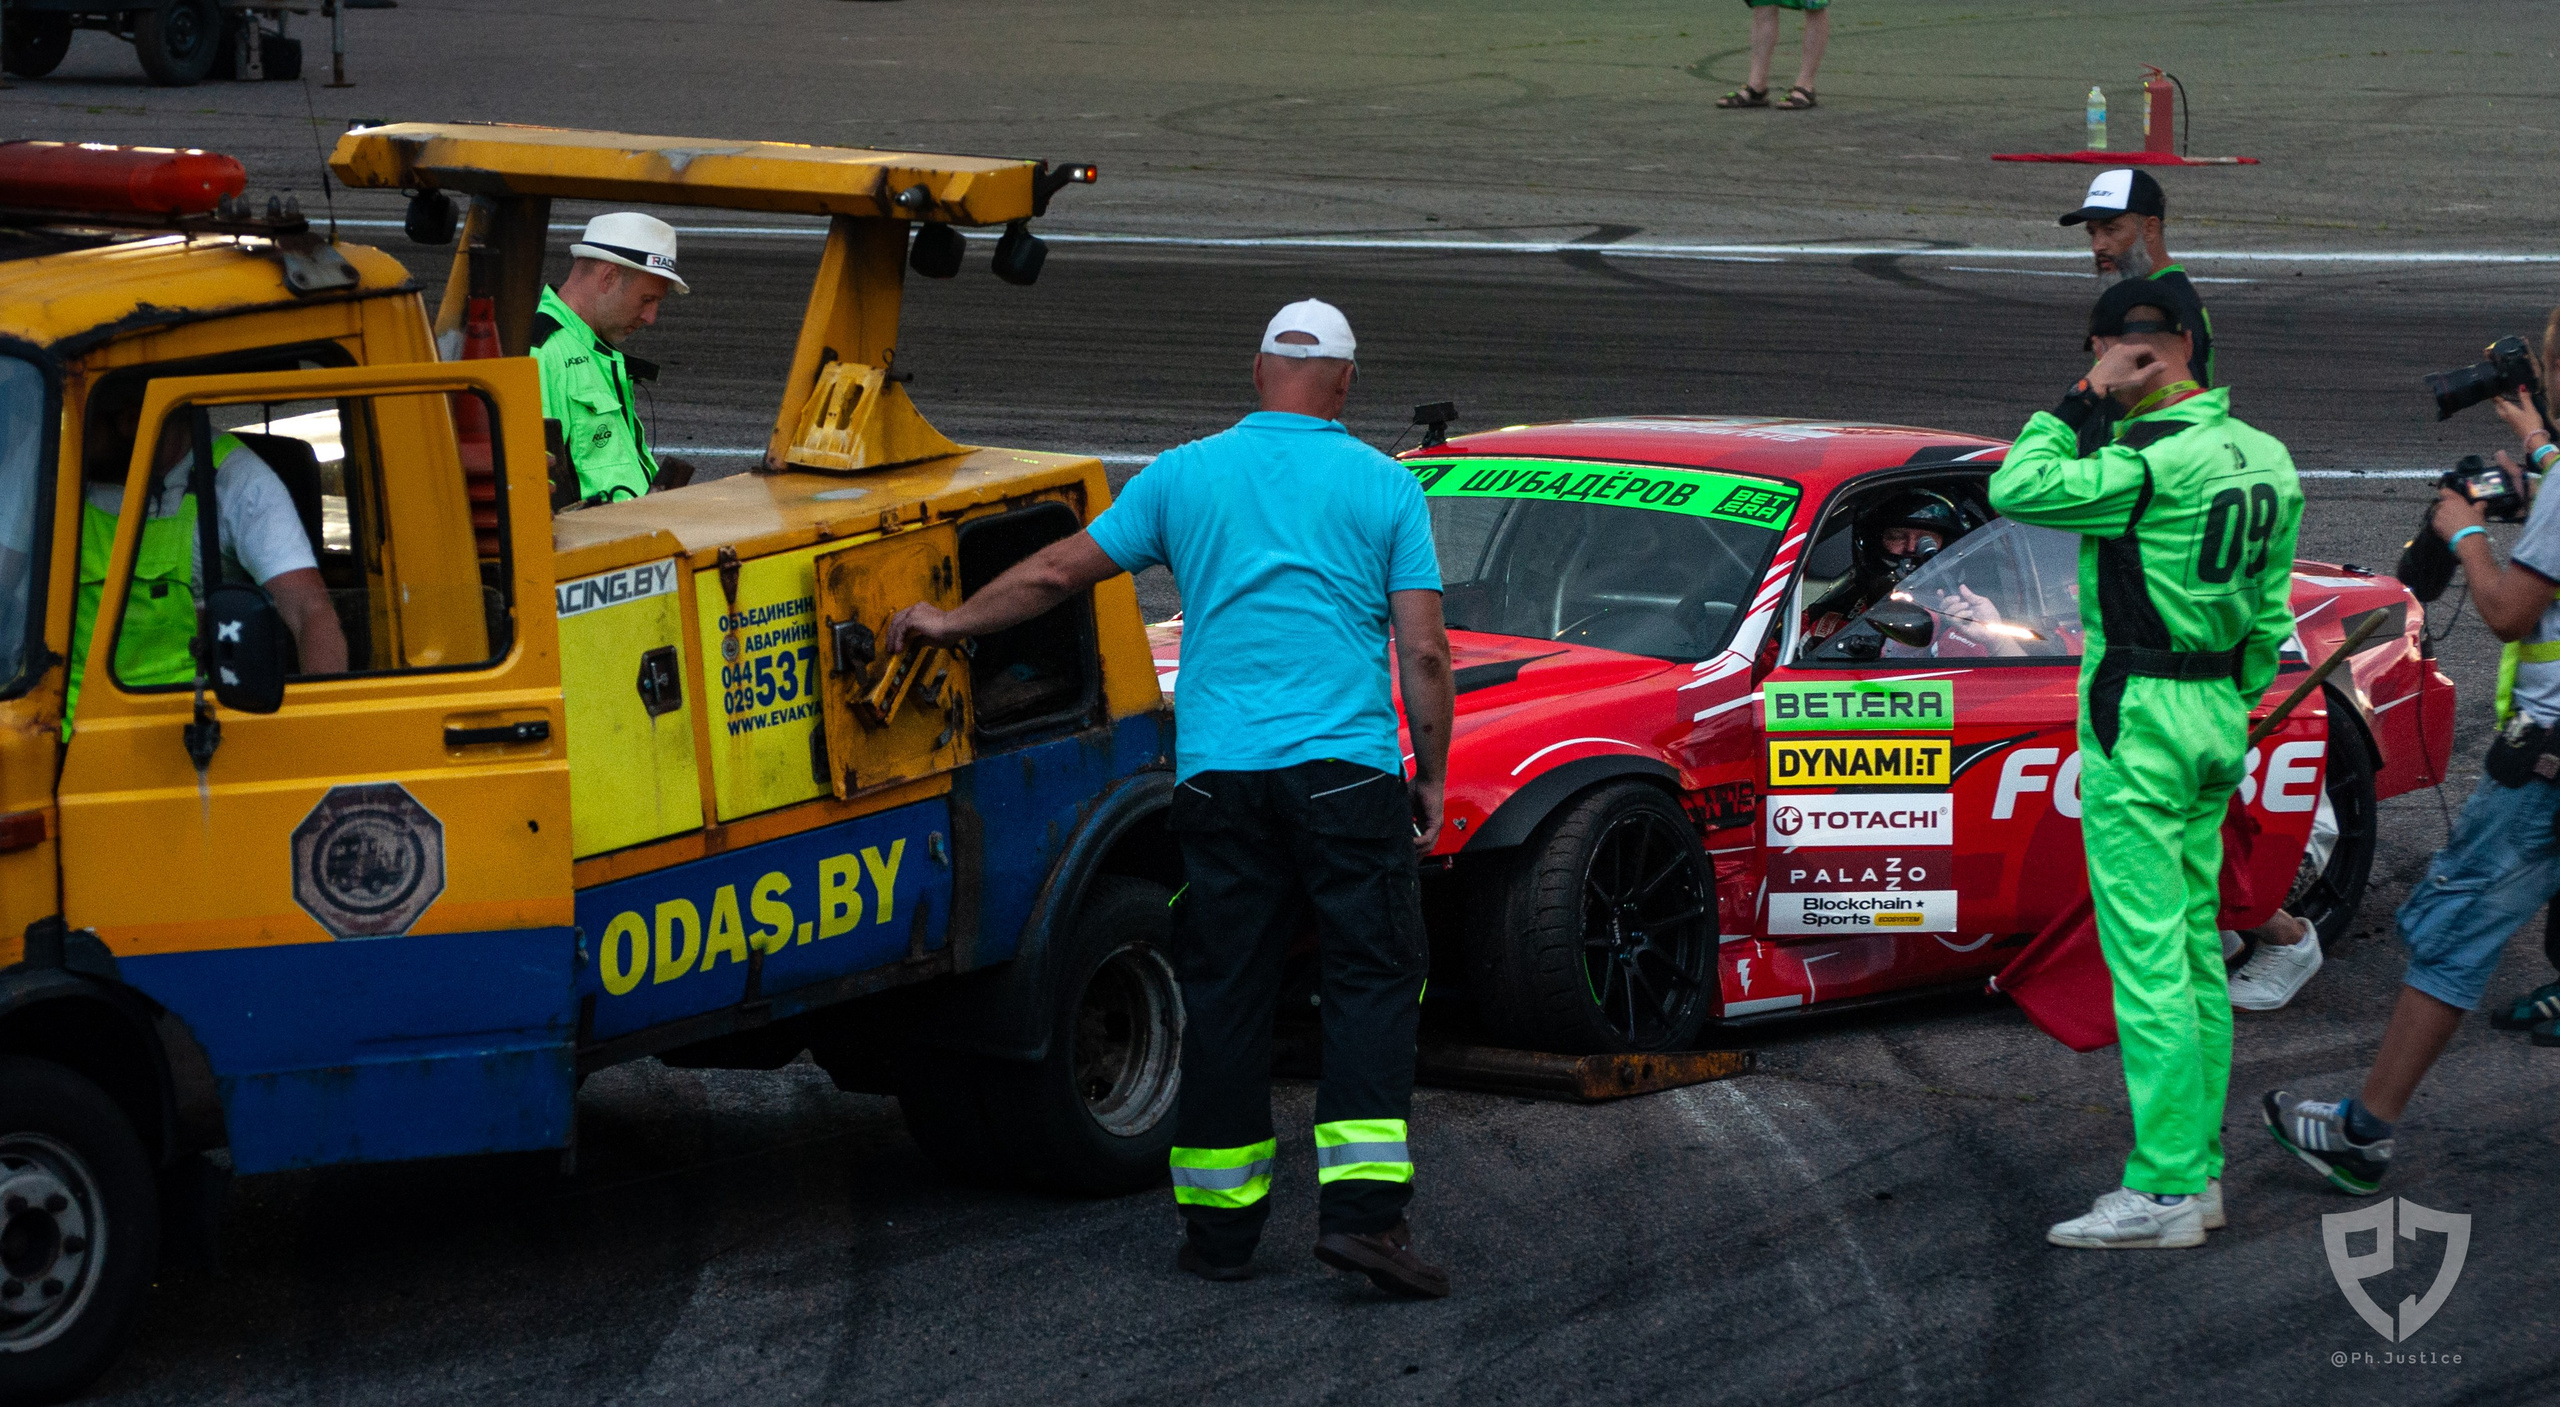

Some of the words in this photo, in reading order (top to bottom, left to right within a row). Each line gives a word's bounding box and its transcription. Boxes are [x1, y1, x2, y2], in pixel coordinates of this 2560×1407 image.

[1458, 469, 1700, 507] ШУБАДЁРОВ
[1732, 489, 1790, 508] BET
[2198, 483, 2278, 584] 09
[721, 661, 753, 689] 044
[755, 645, 819, 707] 537
[724, 687, 754, 715] 029
[599, 838, 907, 996] ODAS.BY
[1802, 913, 1871, 927] Sports
[1803, 897, 1913, 911] Blockchain
